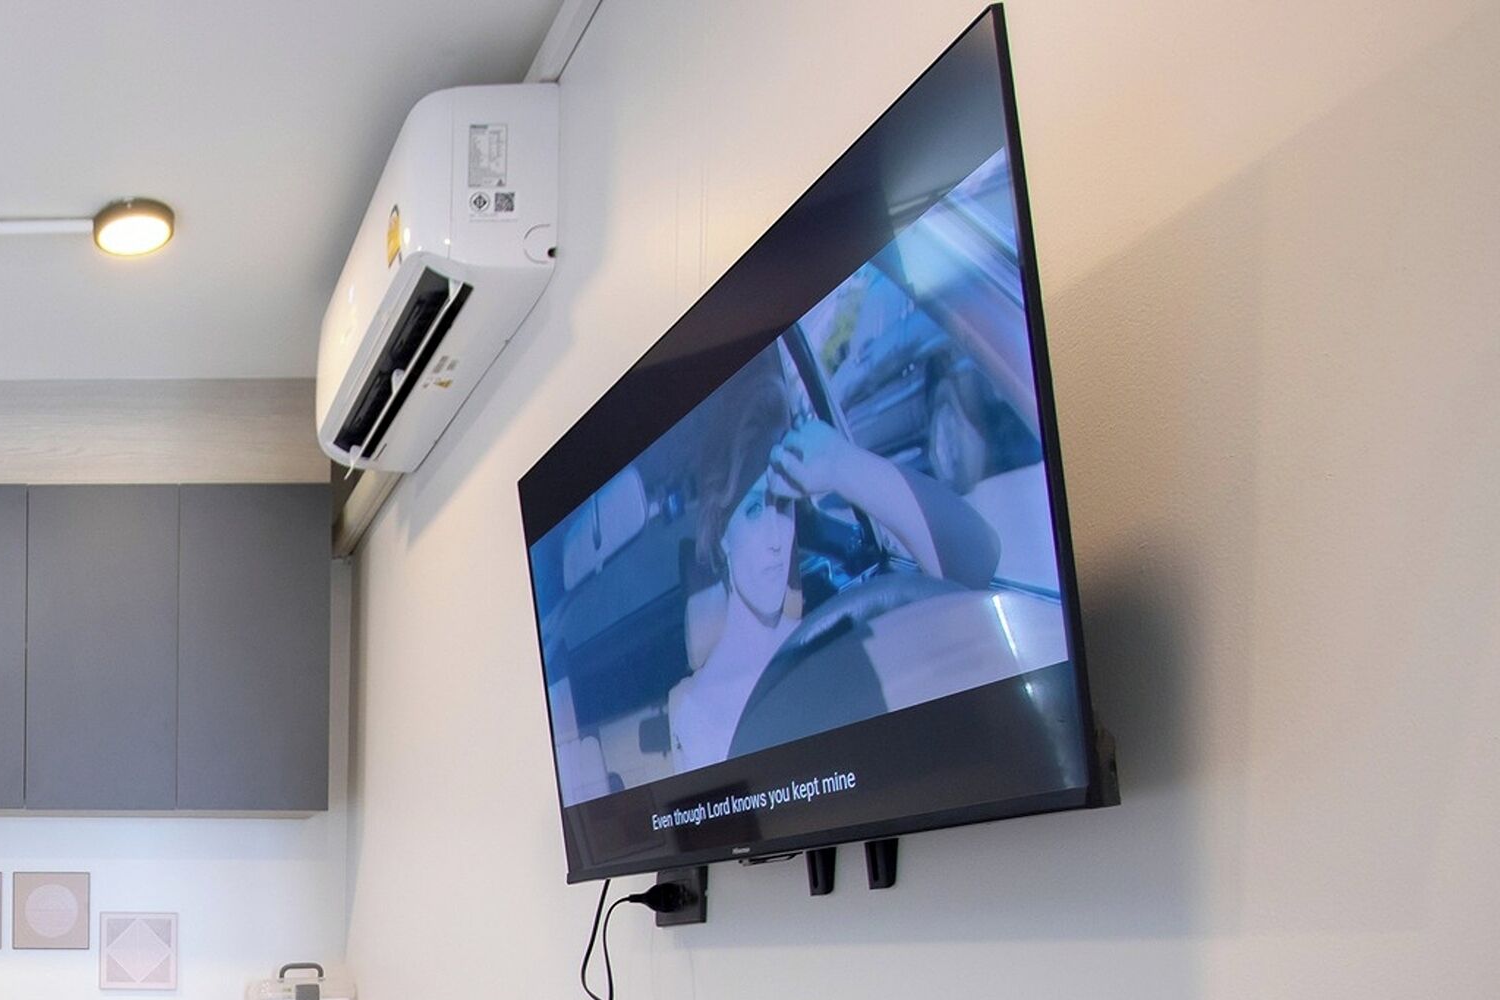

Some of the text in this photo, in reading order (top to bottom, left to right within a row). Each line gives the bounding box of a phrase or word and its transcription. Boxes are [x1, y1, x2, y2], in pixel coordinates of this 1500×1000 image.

[652, 771, 856, 830] Even though Lord knows you kept mine
